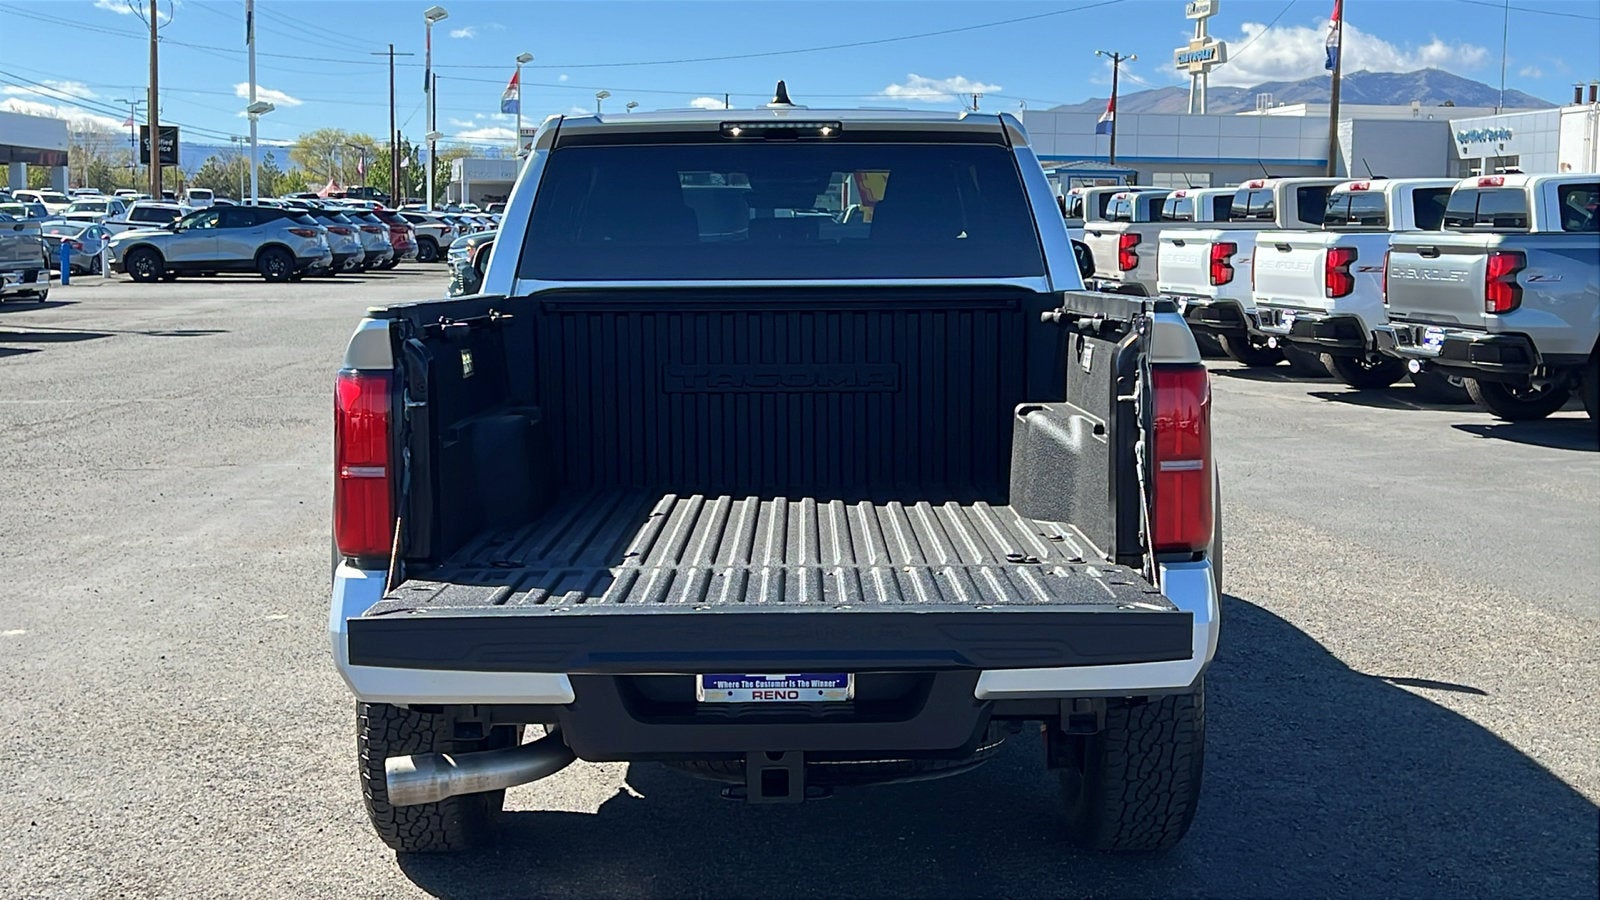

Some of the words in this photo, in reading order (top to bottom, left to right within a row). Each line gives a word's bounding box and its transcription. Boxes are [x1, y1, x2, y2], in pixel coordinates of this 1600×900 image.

[1391, 267, 1469, 282] CHEVROLET
[668, 371, 895, 389] TACOMA
[741, 680, 754, 688] The
[755, 680, 788, 688] Customer
[789, 680, 796, 688] Is
[797, 680, 810, 688] The
[752, 690, 799, 700] RENO
